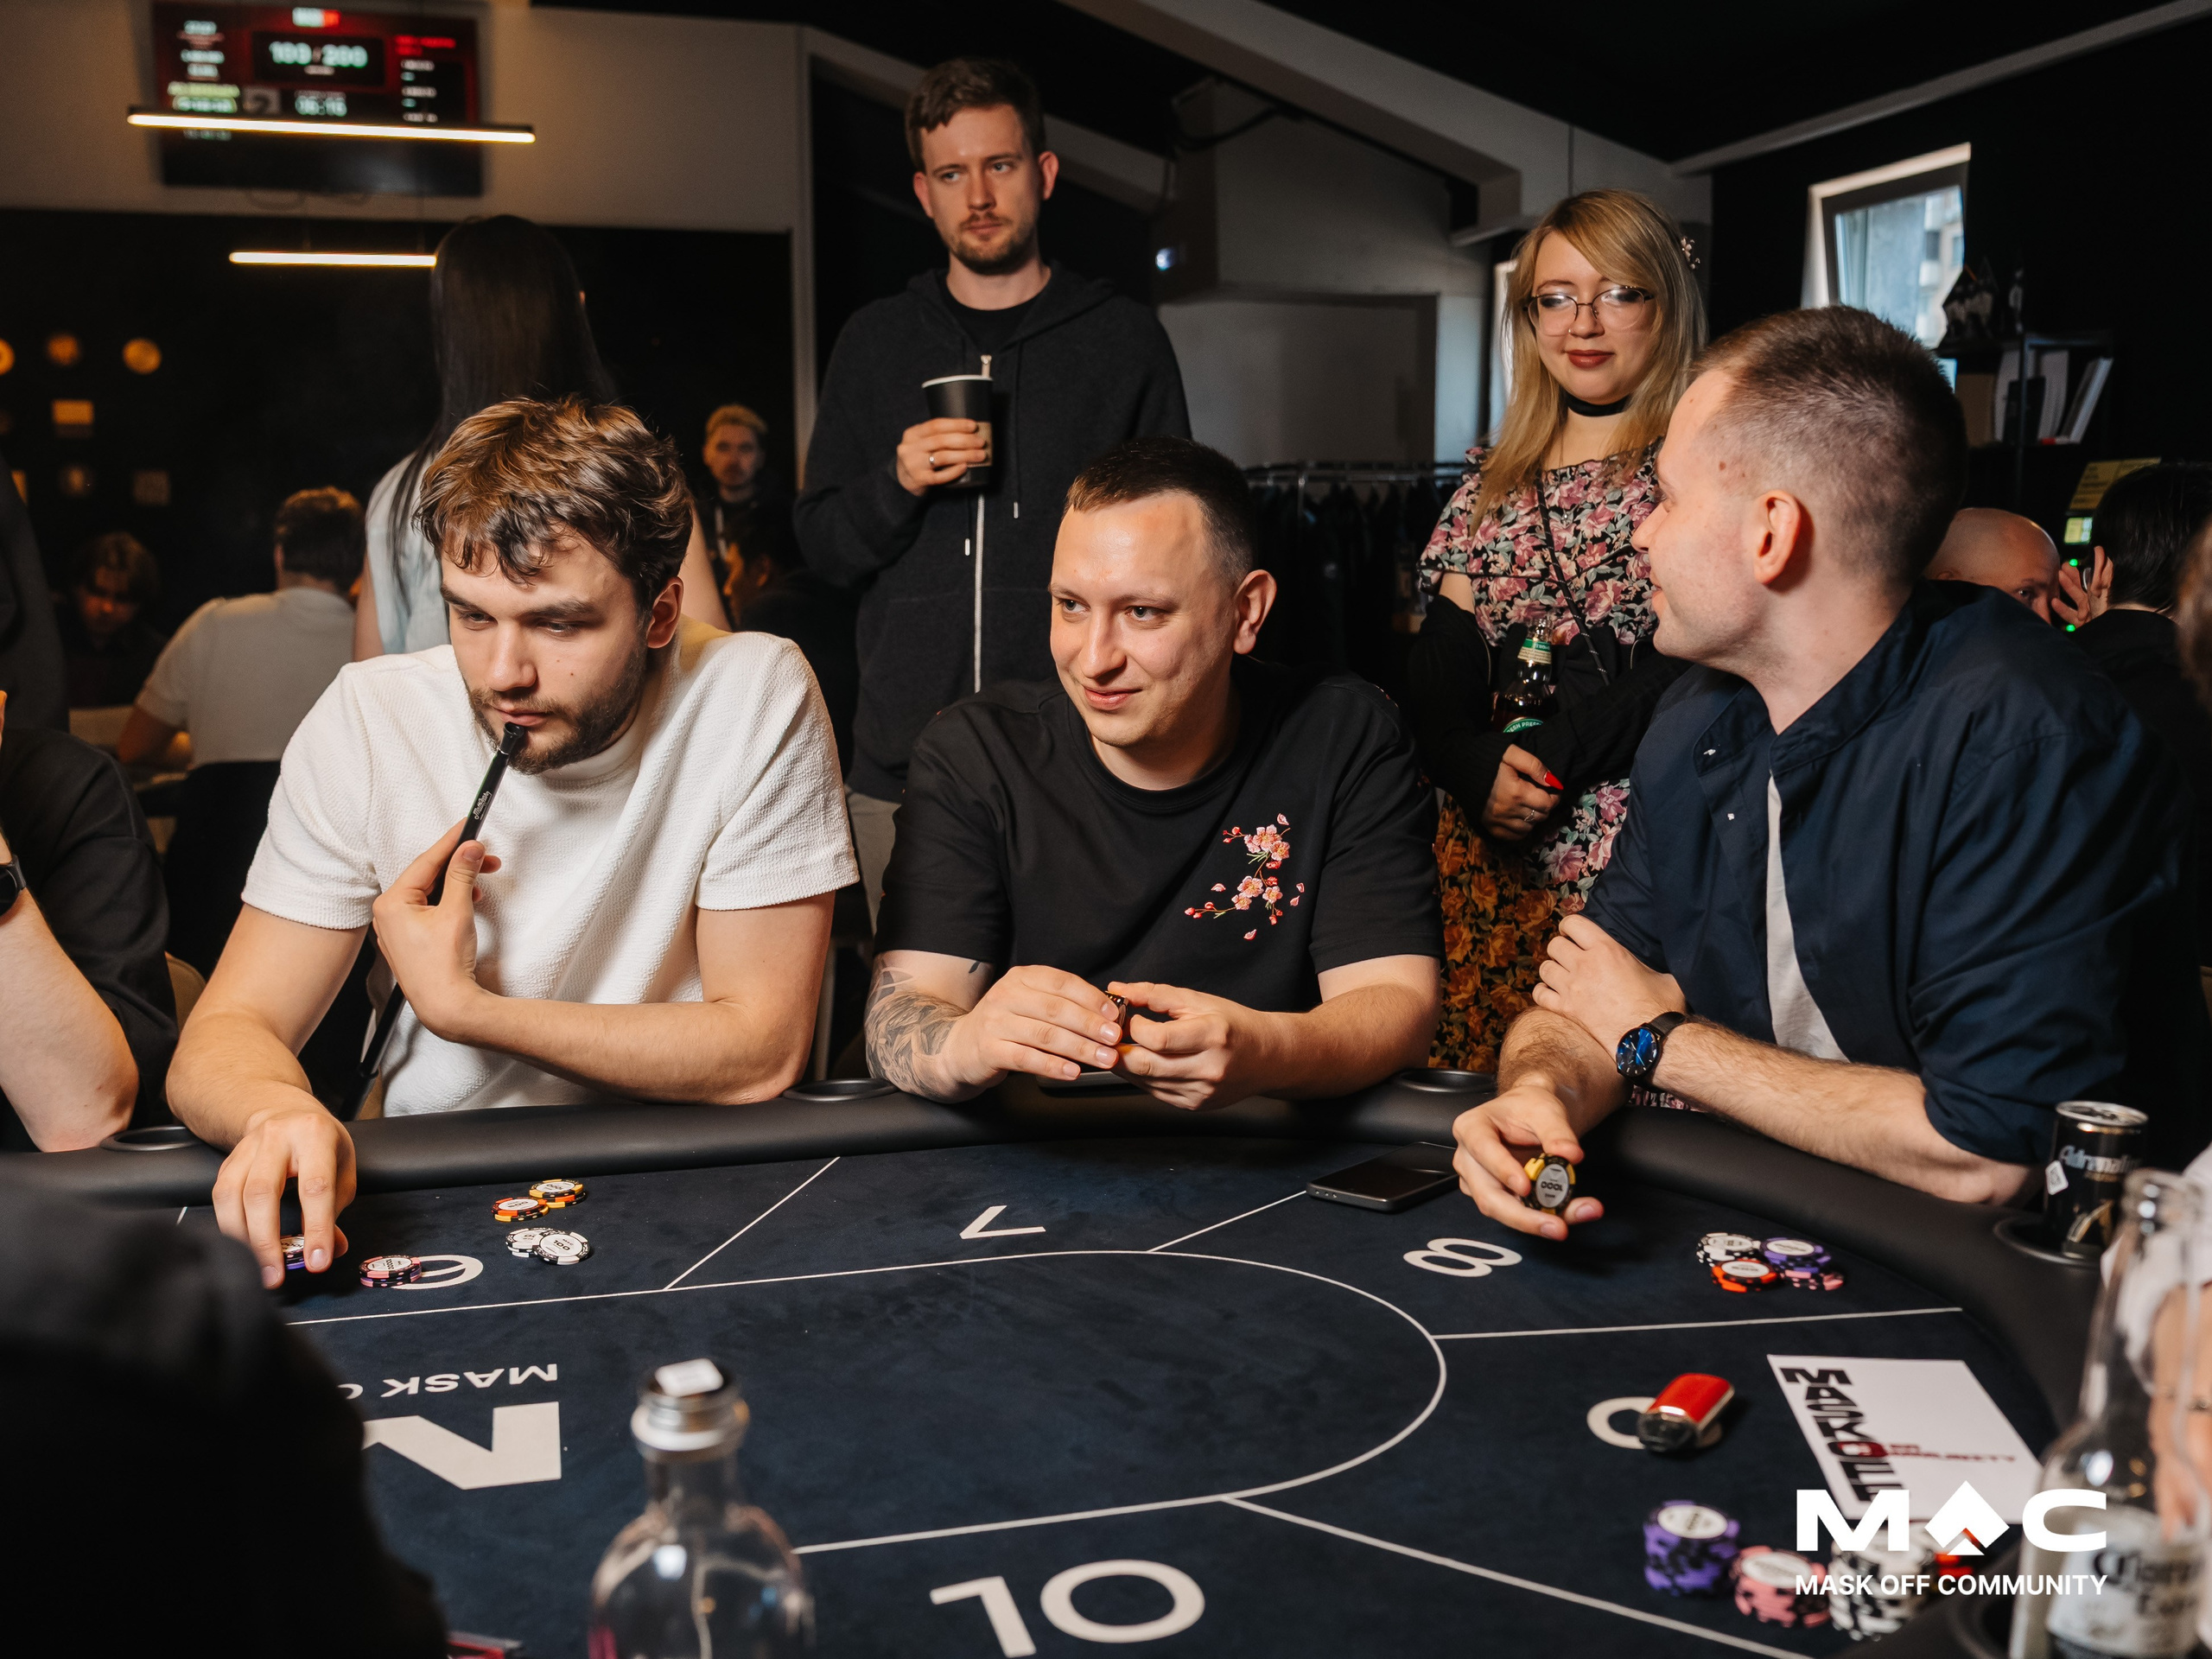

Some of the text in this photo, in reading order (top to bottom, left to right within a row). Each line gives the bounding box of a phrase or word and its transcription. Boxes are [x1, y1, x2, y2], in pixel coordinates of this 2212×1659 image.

[959, 1205, 1046, 1239] 7
[554, 1239, 570, 1251] 100
[1403, 1237, 1522, 1278] 8
[381, 1363, 558, 1398] MASK
[929, 1559, 1205, 1658] 10
